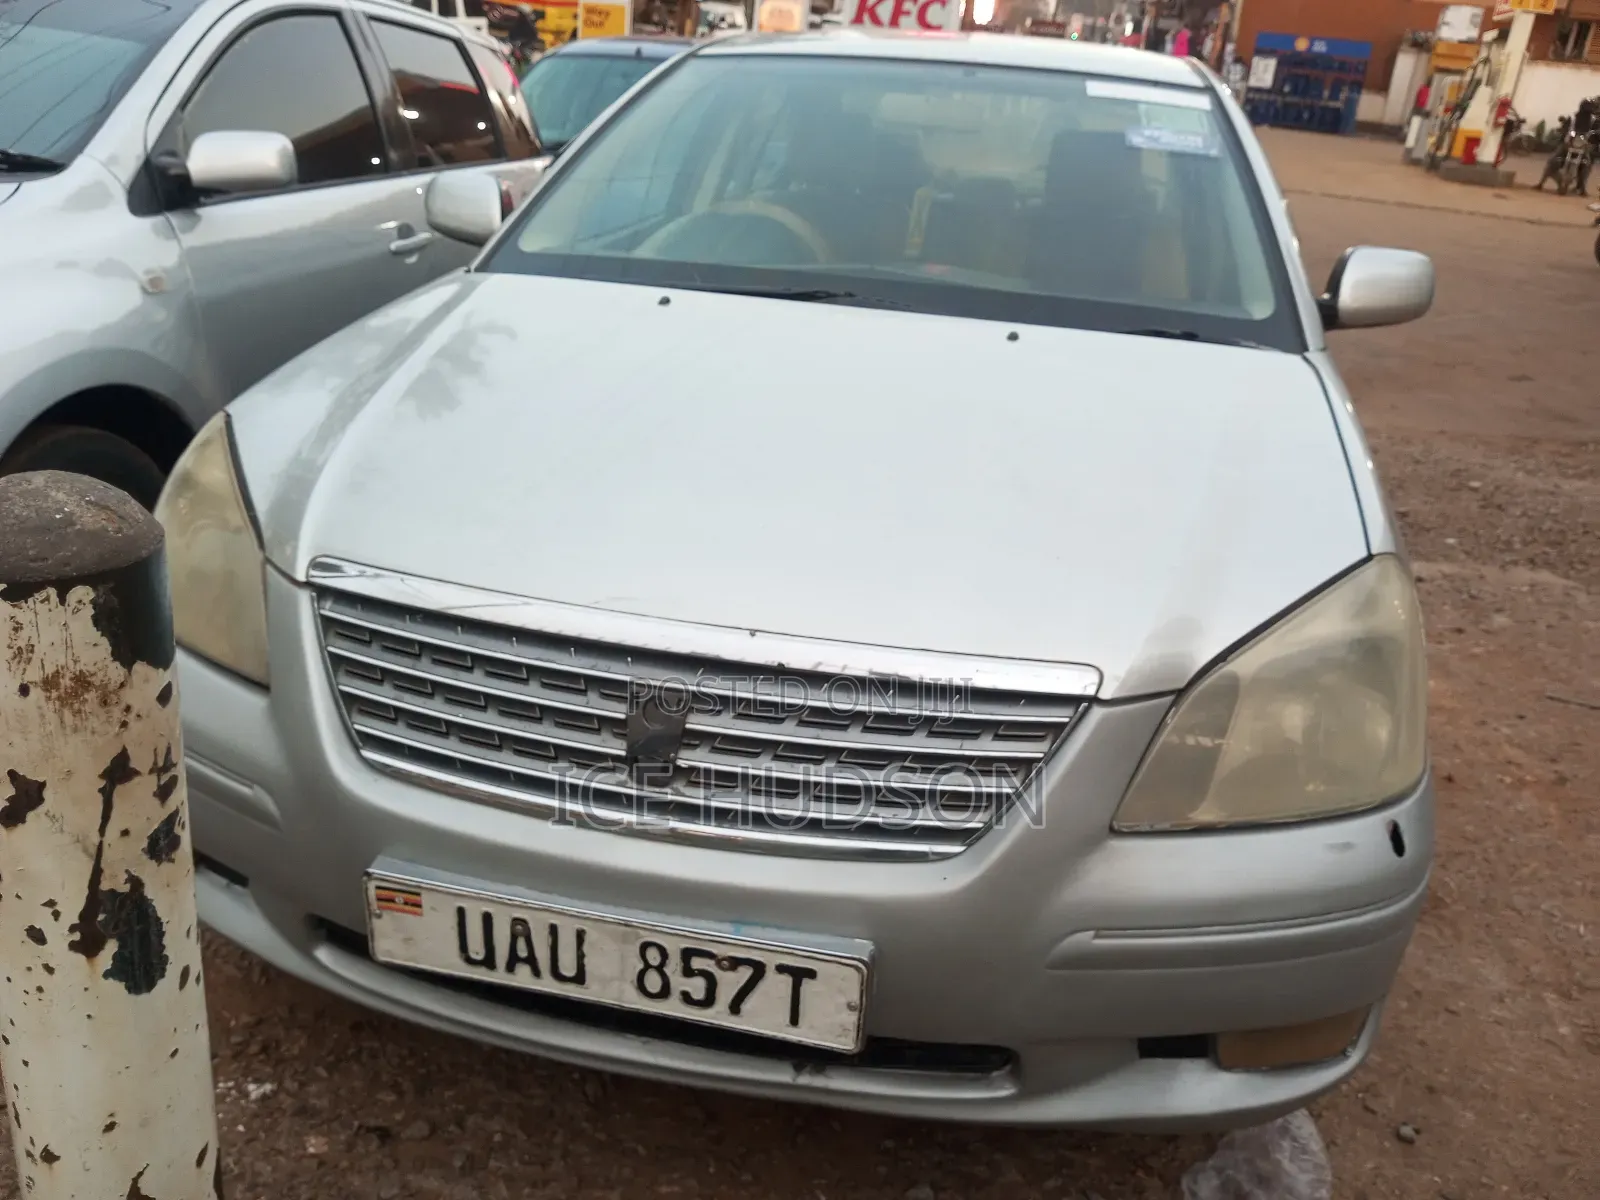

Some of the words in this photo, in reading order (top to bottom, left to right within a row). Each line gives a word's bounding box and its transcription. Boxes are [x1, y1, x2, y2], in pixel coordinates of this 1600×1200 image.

[850, 0, 947, 30] KFC
[456, 905, 587, 986] UAU
[635, 940, 818, 1027] 857T
